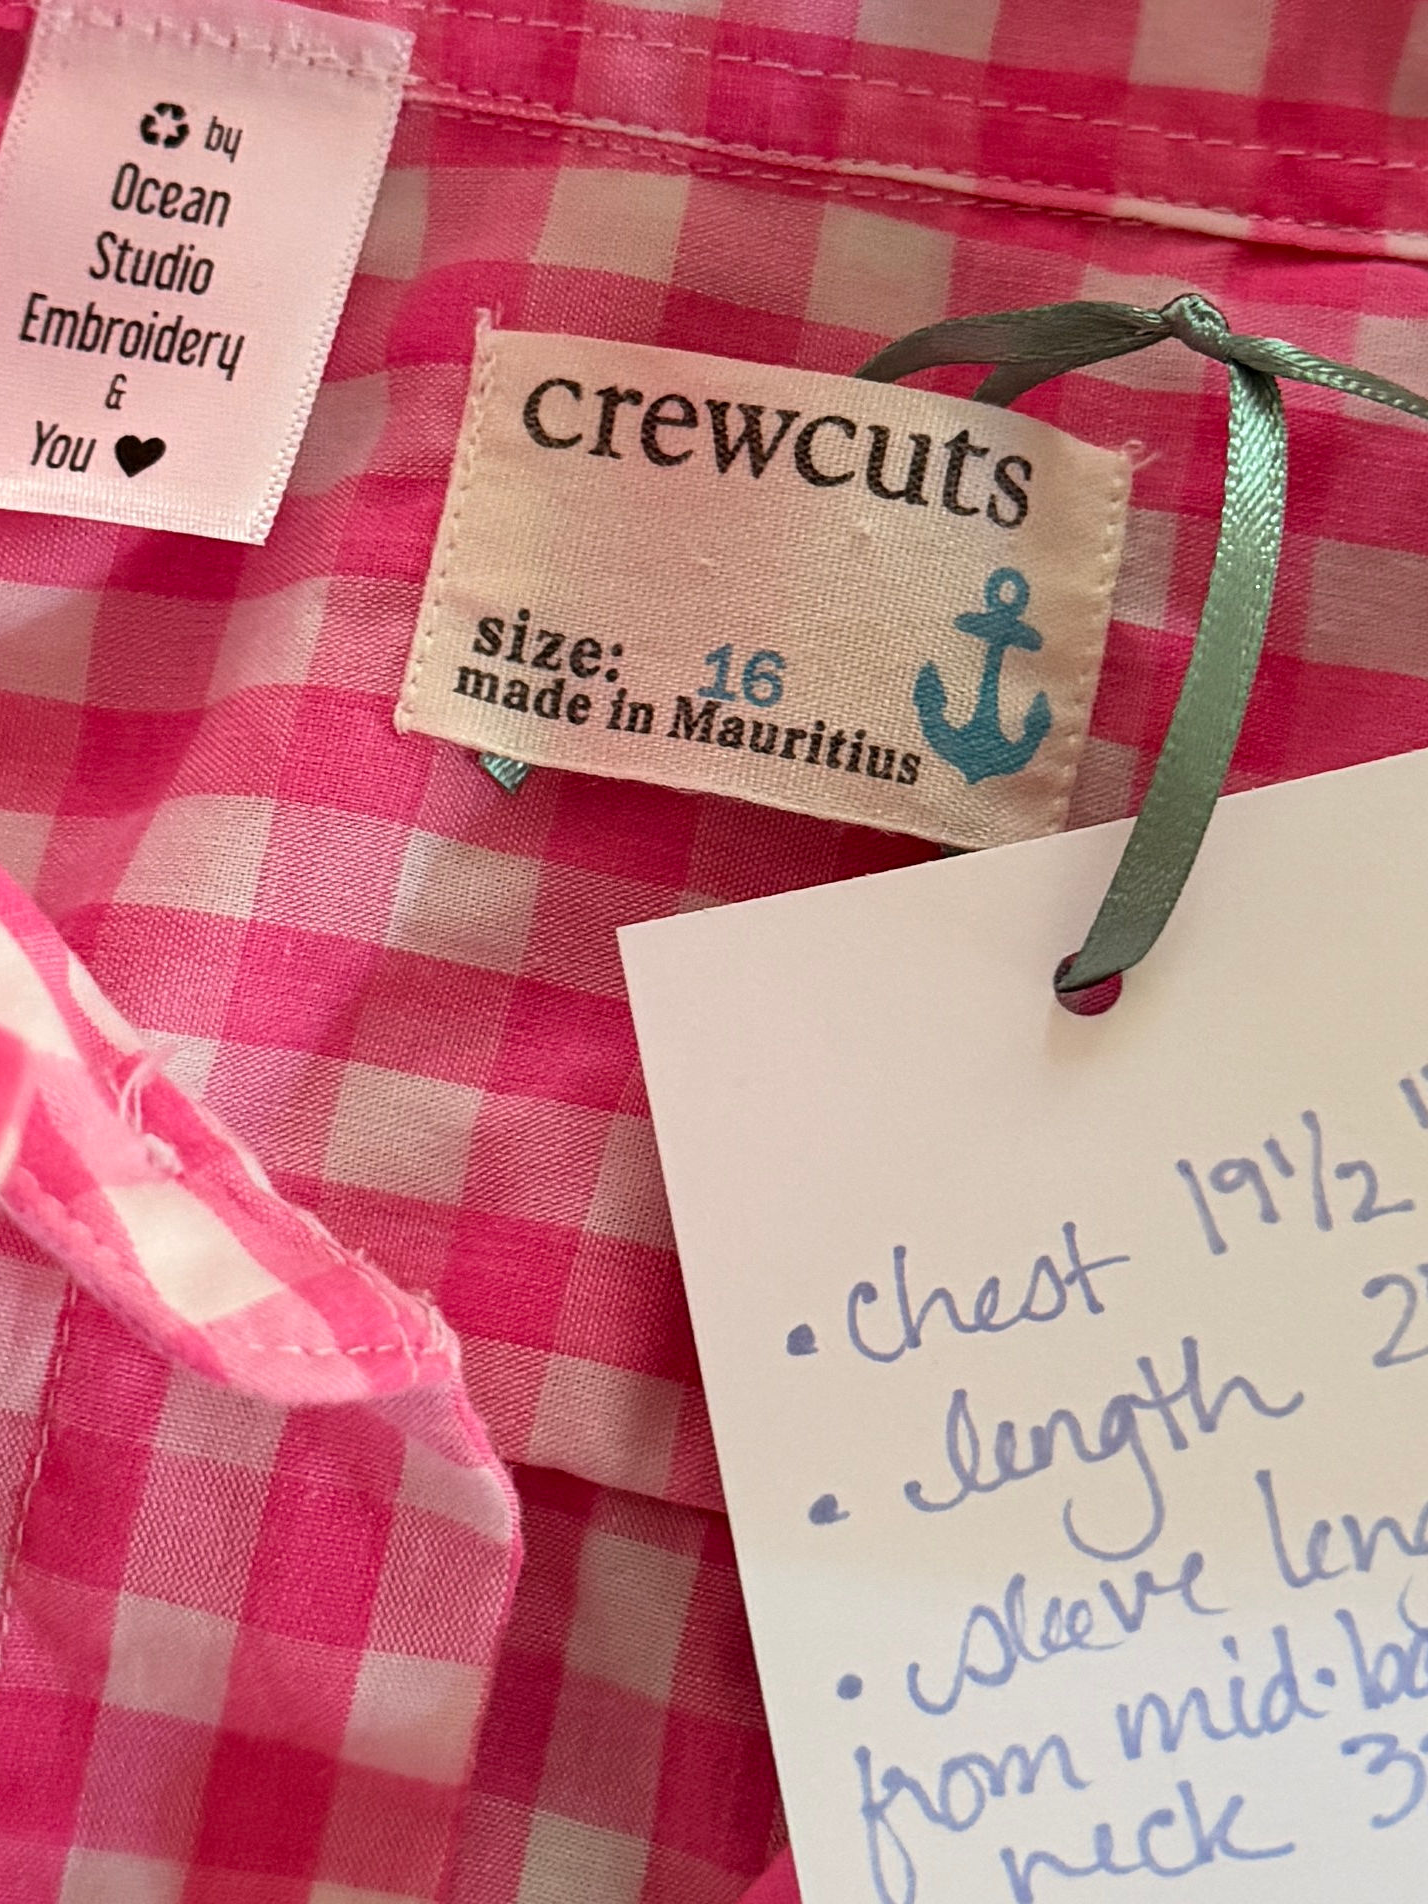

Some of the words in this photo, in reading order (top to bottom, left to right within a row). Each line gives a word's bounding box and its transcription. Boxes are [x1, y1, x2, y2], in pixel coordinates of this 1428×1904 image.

[204, 115, 244, 163] by
[109, 161, 233, 229] Ocean
[88, 229, 216, 296] Studio
[17, 292, 247, 383] Embroidery
[104, 372, 128, 411] &
[29, 420, 97, 474] You
[521, 376, 1035, 531] crewcuts
[471, 608, 625, 683] size:
[696, 642, 789, 709] 16
[452, 661, 592, 727] made
[606, 687, 655, 736] in
[667, 695, 923, 787] Mauritius
[846, 1221, 1132, 1364] chest
[902, 1338, 1303, 1561] length
